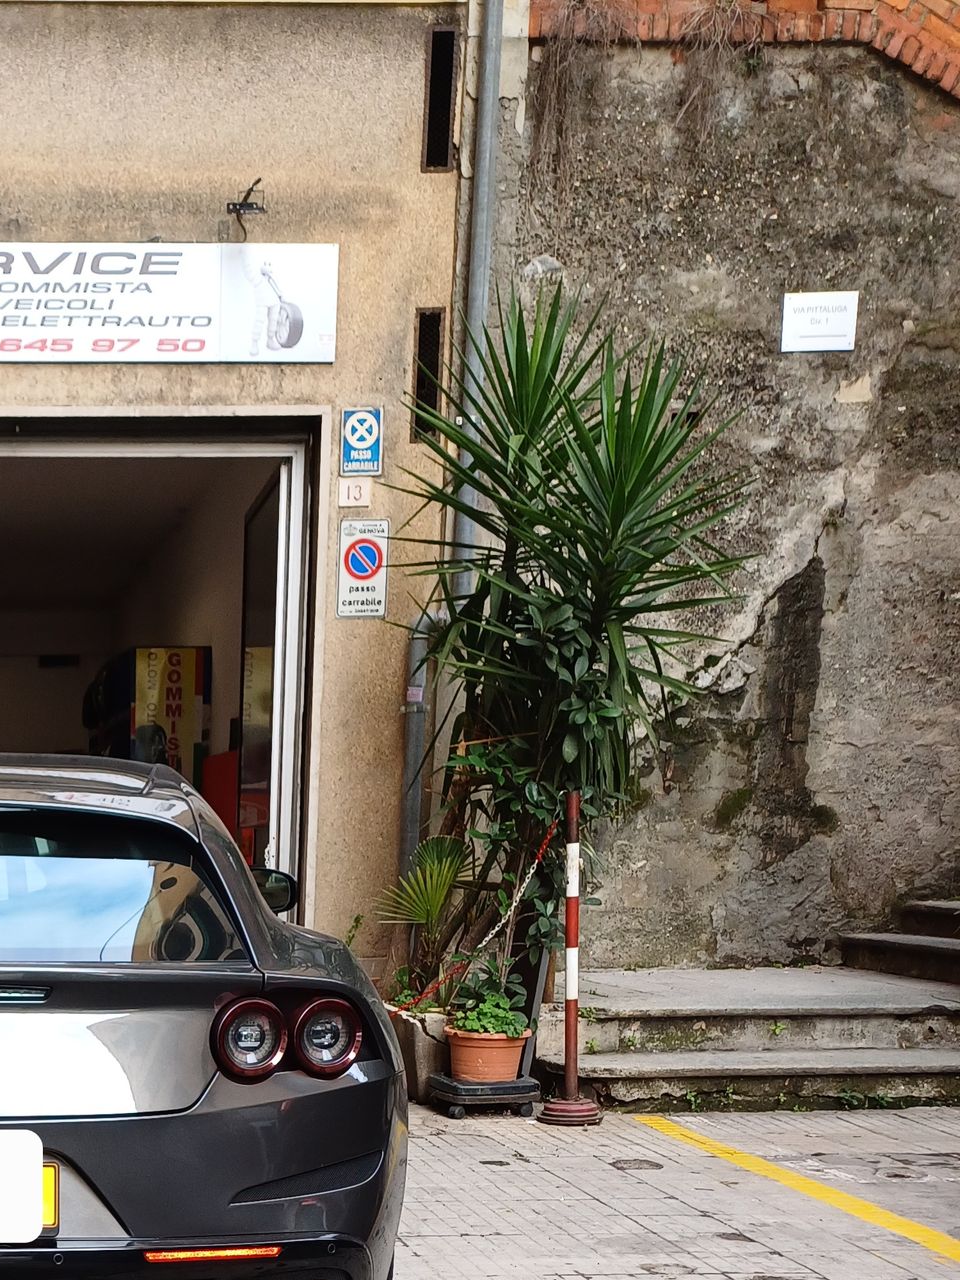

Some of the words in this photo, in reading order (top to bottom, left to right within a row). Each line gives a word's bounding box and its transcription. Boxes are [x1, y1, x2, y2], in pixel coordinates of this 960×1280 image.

[0, 315, 212, 328] ELETTRAUTO
[91, 338, 140, 353] 97
[156, 338, 206, 353] 50
[350, 449, 372, 460] PASSO
[343, 460, 379, 471] CARRABILE
[347, 484, 362, 501] 13
[348, 585, 376, 594] passo
[341, 597, 382, 606] carrabile
